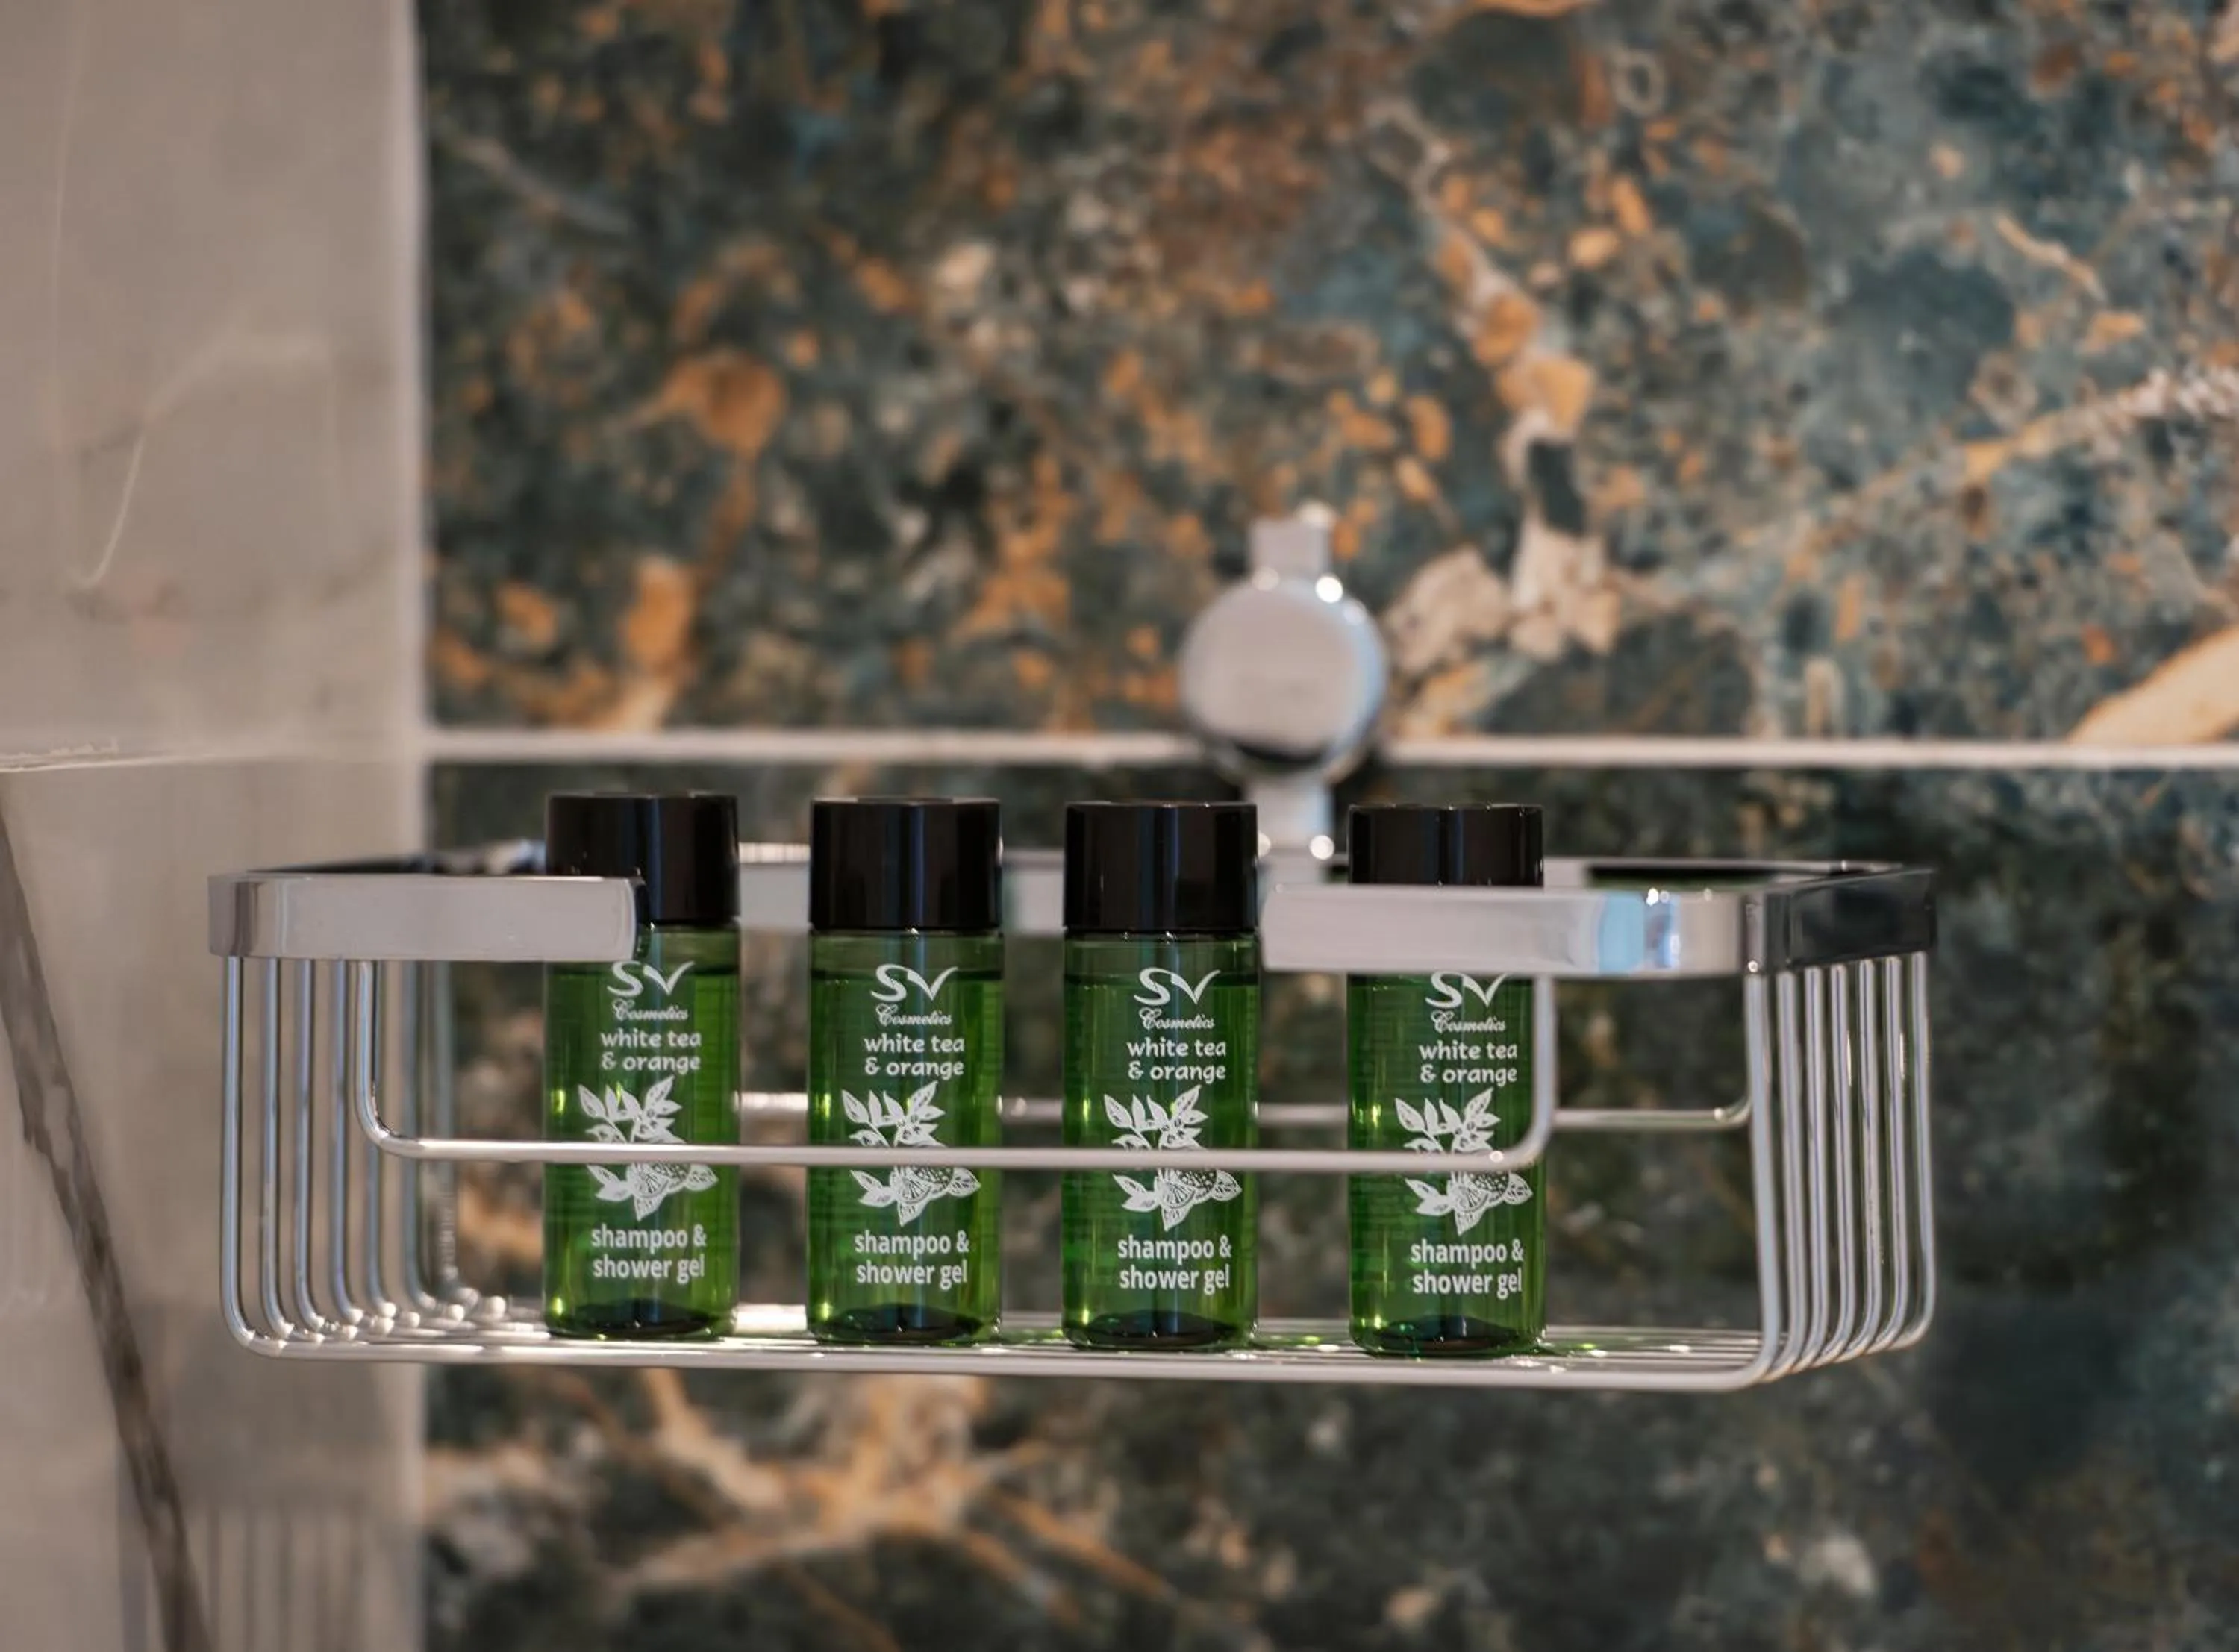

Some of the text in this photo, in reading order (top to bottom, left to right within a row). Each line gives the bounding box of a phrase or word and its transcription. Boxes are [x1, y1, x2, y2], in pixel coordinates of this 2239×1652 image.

[600, 1027, 702, 1048] white tea
[863, 1032, 964, 1054] white tea
[1126, 1036, 1226, 1057] white tea
[1418, 1039, 1517, 1060] white tea
[601, 1051, 701, 1076] & orange
[864, 1056, 964, 1081] & orange
[1128, 1060, 1226, 1085] & orange
[1420, 1063, 1517, 1087] & orange
[590, 1223, 707, 1255] shampoo &
[854, 1229, 969, 1260] shampoo &
[1117, 1233, 1231, 1265] shampoo &
[1410, 1238, 1524, 1270] shampoo &
[593, 1254, 705, 1286] shower gel
[855, 1259, 967, 1292] shower gel
[1119, 1263, 1230, 1296] shower gel
[1411, 1268, 1522, 1300] shower gel
